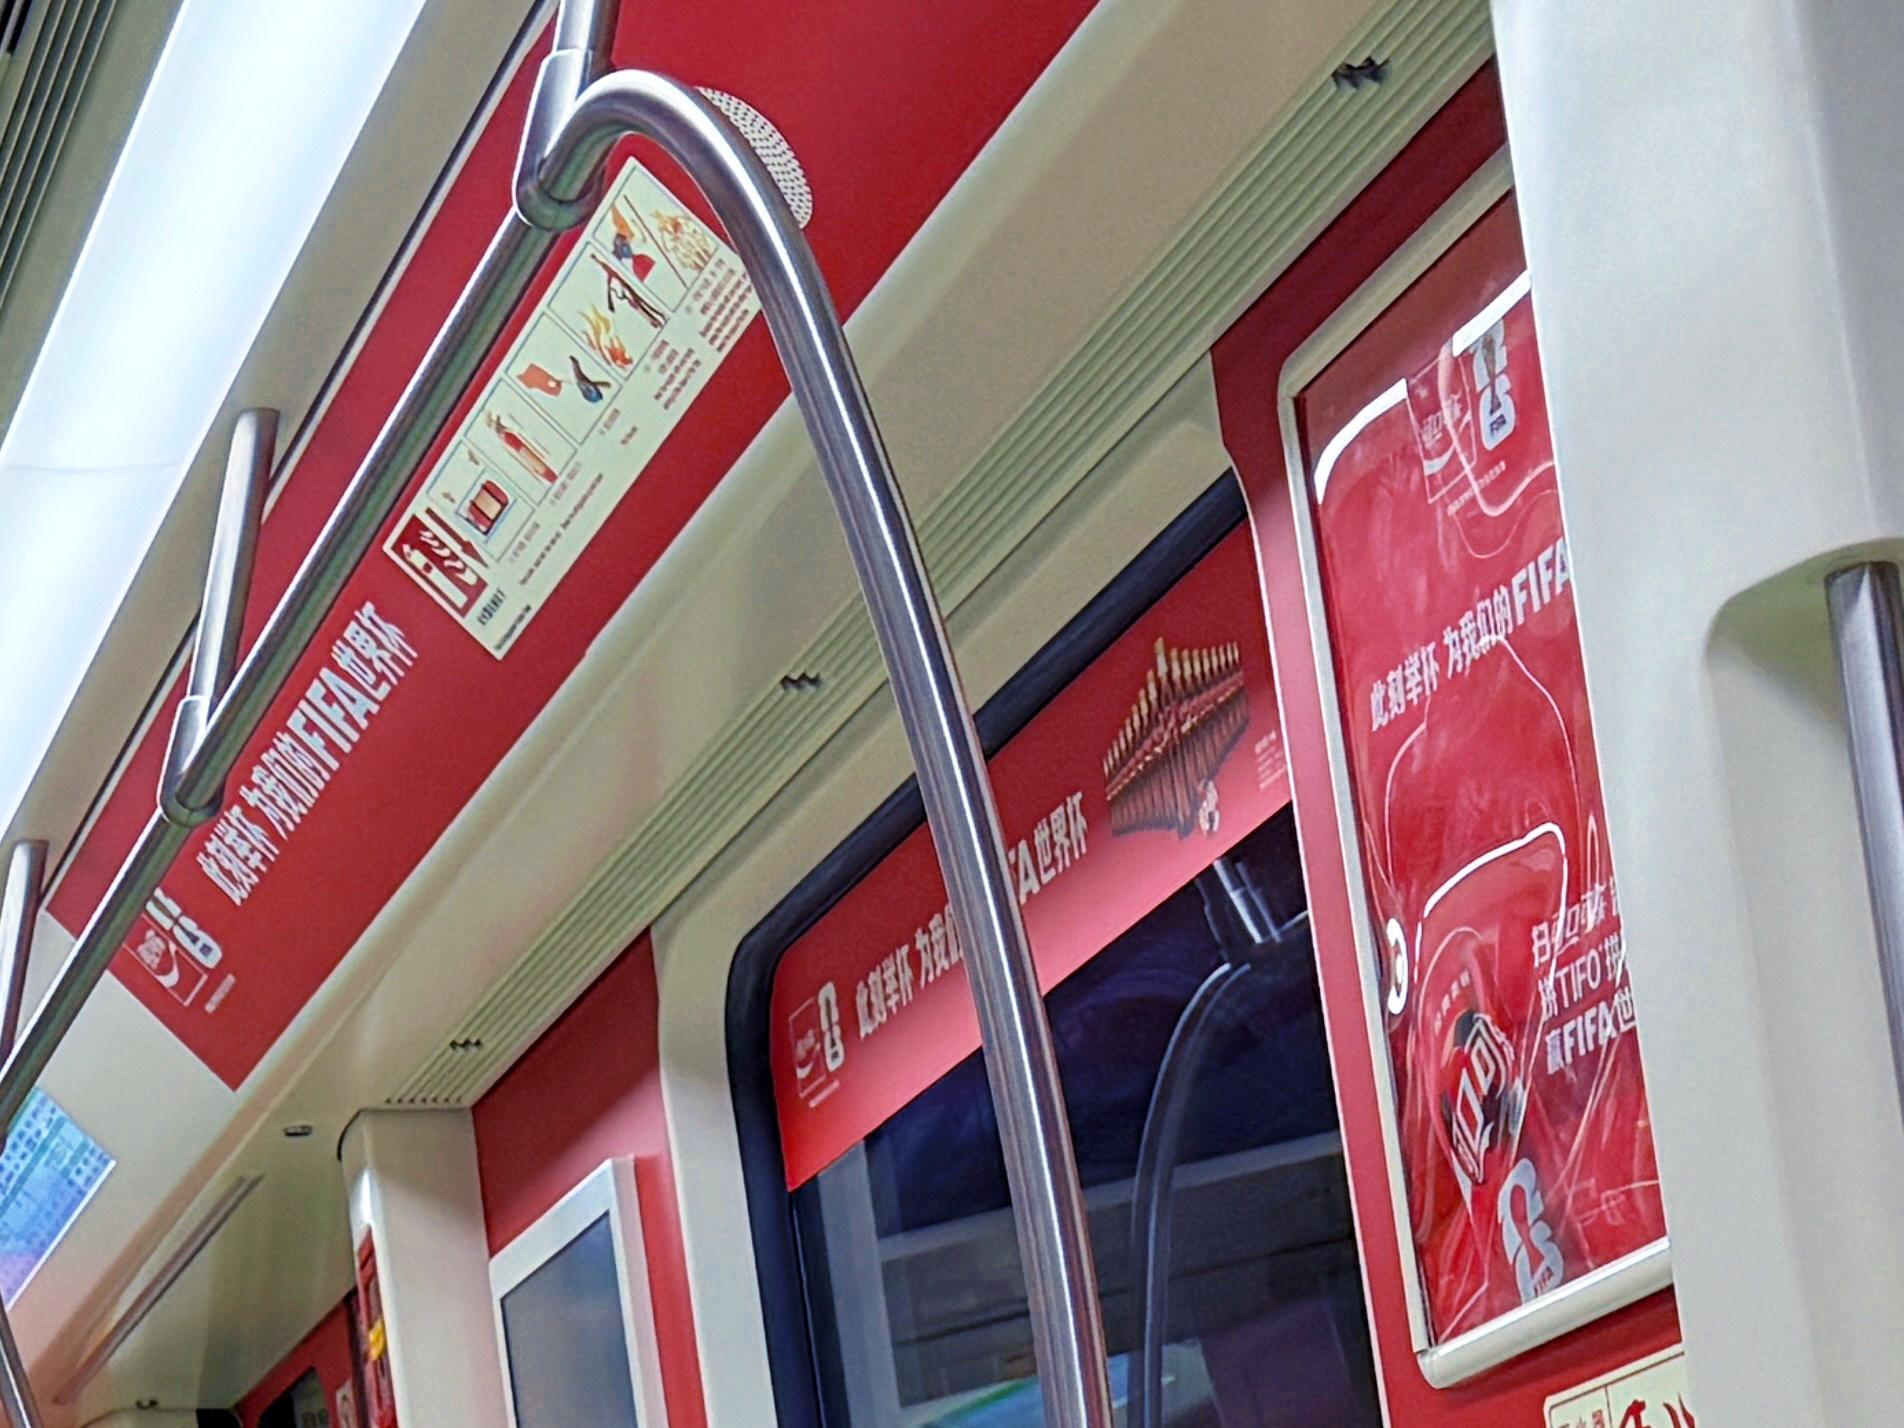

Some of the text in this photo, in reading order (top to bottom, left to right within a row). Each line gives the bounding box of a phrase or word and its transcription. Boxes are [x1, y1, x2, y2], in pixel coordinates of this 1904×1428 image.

[1371, 641, 1440, 732] 此刻举杯
[196, 601, 419, 907] 此刻举杯 为我们的FIFA世界杯
[856, 944, 914, 1040] 此刻举杯
